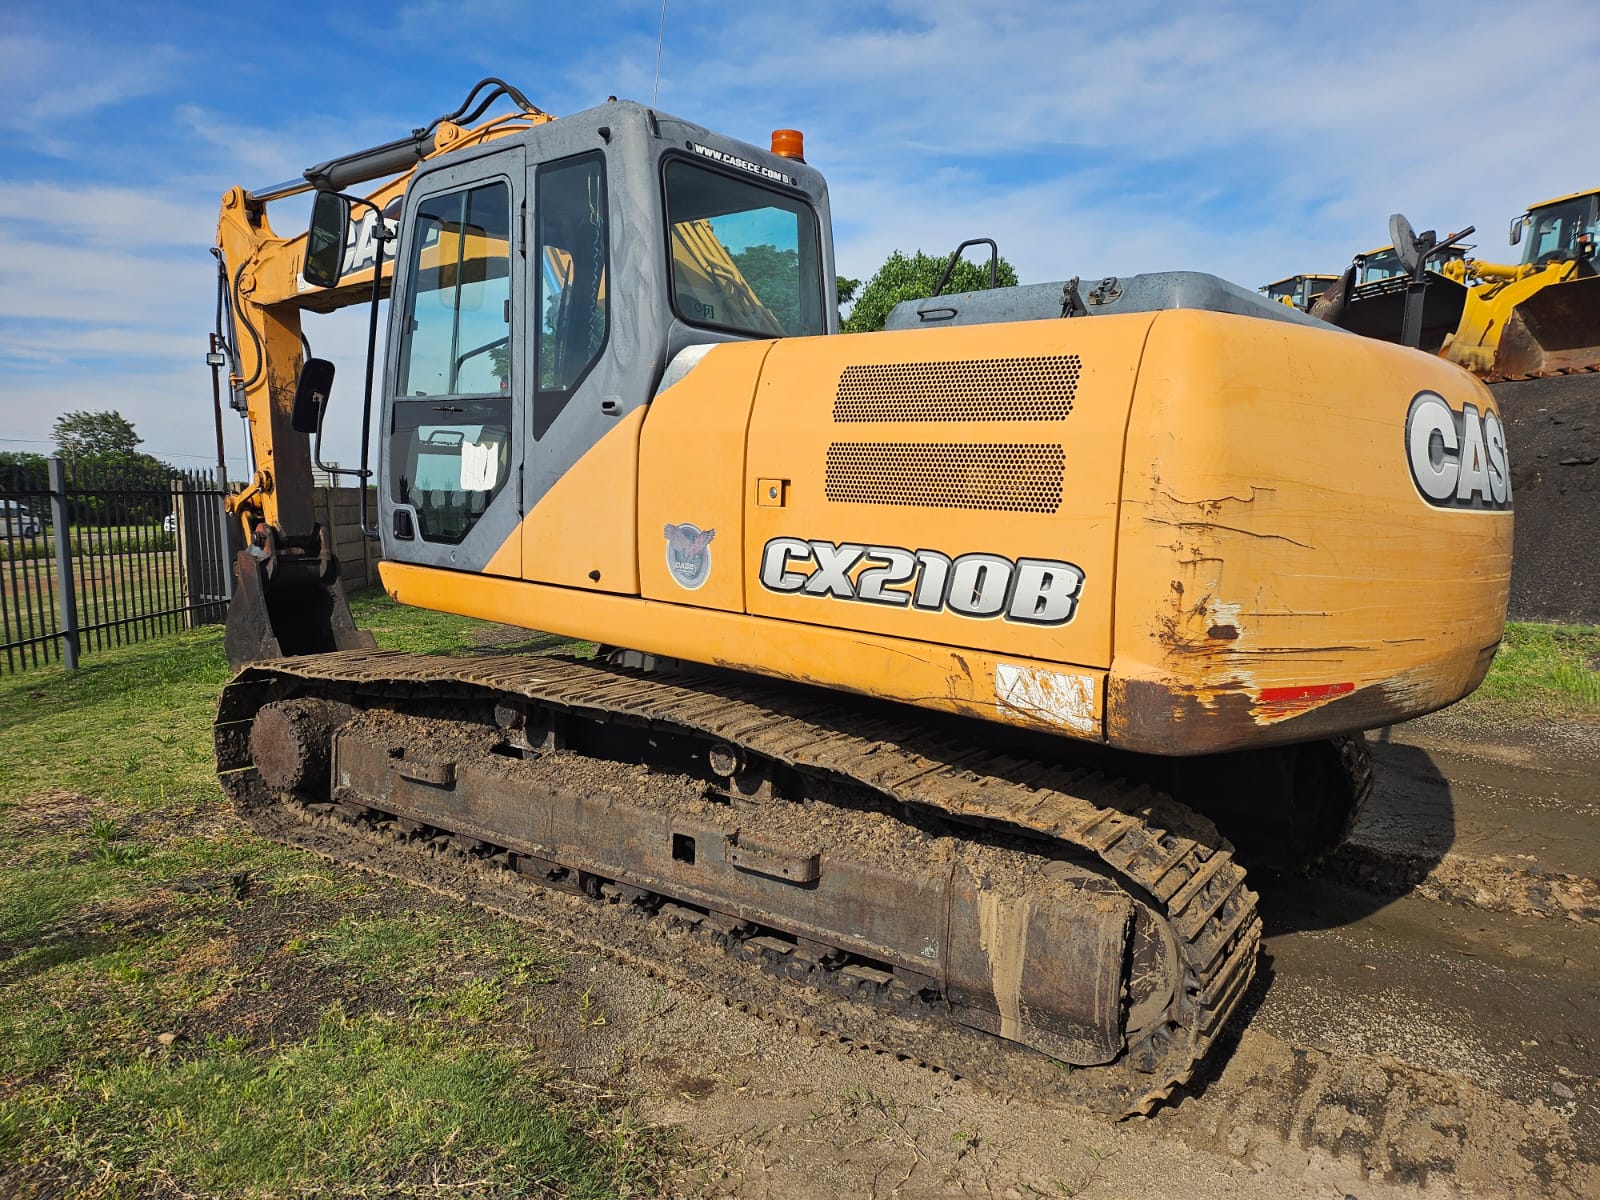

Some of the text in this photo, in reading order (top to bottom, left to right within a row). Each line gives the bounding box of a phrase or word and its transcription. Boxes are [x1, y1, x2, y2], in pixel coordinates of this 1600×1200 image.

[694, 142, 782, 181] WWW.CASECE.COM
[1405, 390, 1512, 508] CAS
[759, 536, 1086, 626] CX210B
